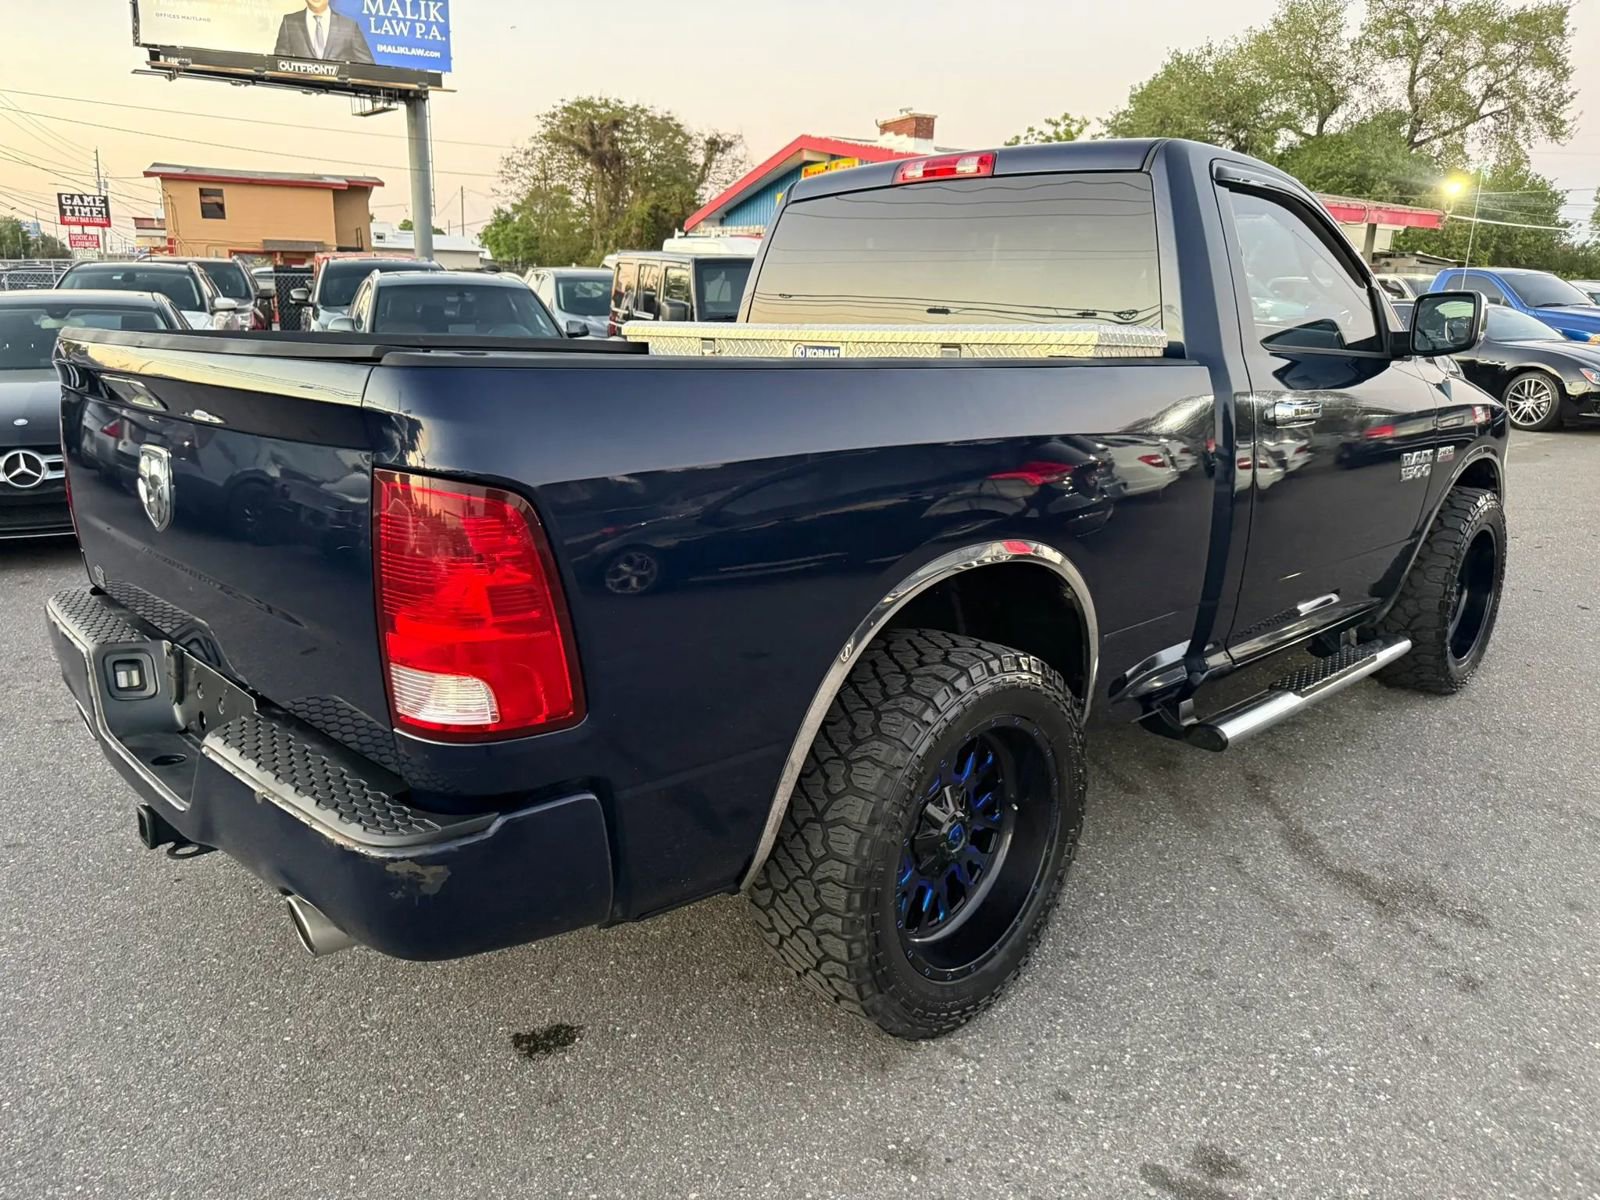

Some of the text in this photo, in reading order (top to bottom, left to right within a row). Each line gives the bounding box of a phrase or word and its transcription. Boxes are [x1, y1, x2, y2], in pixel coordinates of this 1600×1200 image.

[362, 0, 445, 22] MALIK
[369, 17, 446, 40] LAW P.A.
[61, 195, 105, 206] GAME
[63, 206, 106, 217] TIME!
[806, 348, 839, 358] KOBALT
